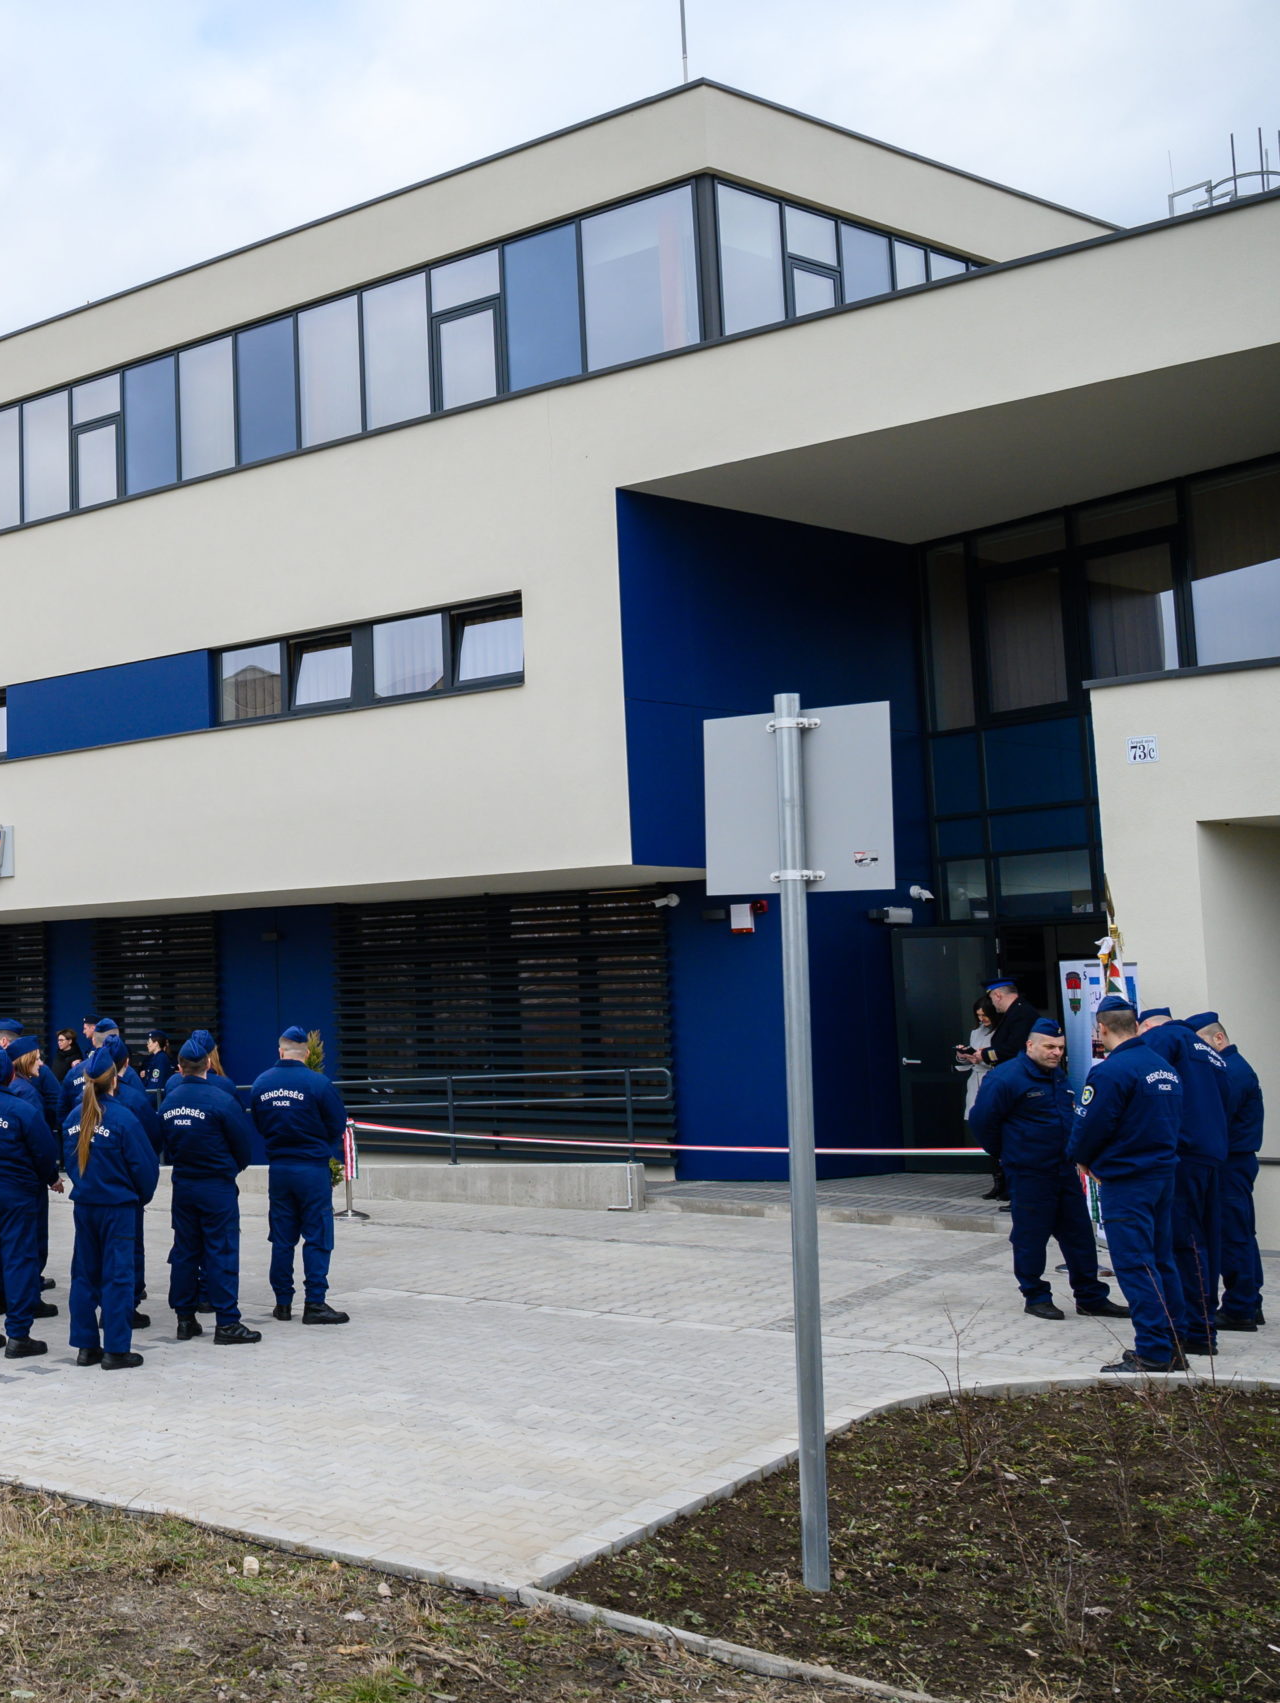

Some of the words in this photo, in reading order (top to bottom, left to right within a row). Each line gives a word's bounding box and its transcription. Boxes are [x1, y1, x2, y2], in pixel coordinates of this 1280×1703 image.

[260, 1088, 305, 1102] RENDŐRSÉG
[163, 1106, 206, 1120] RENDŐRSÉG
[68, 1123, 111, 1138] RENSÉG
